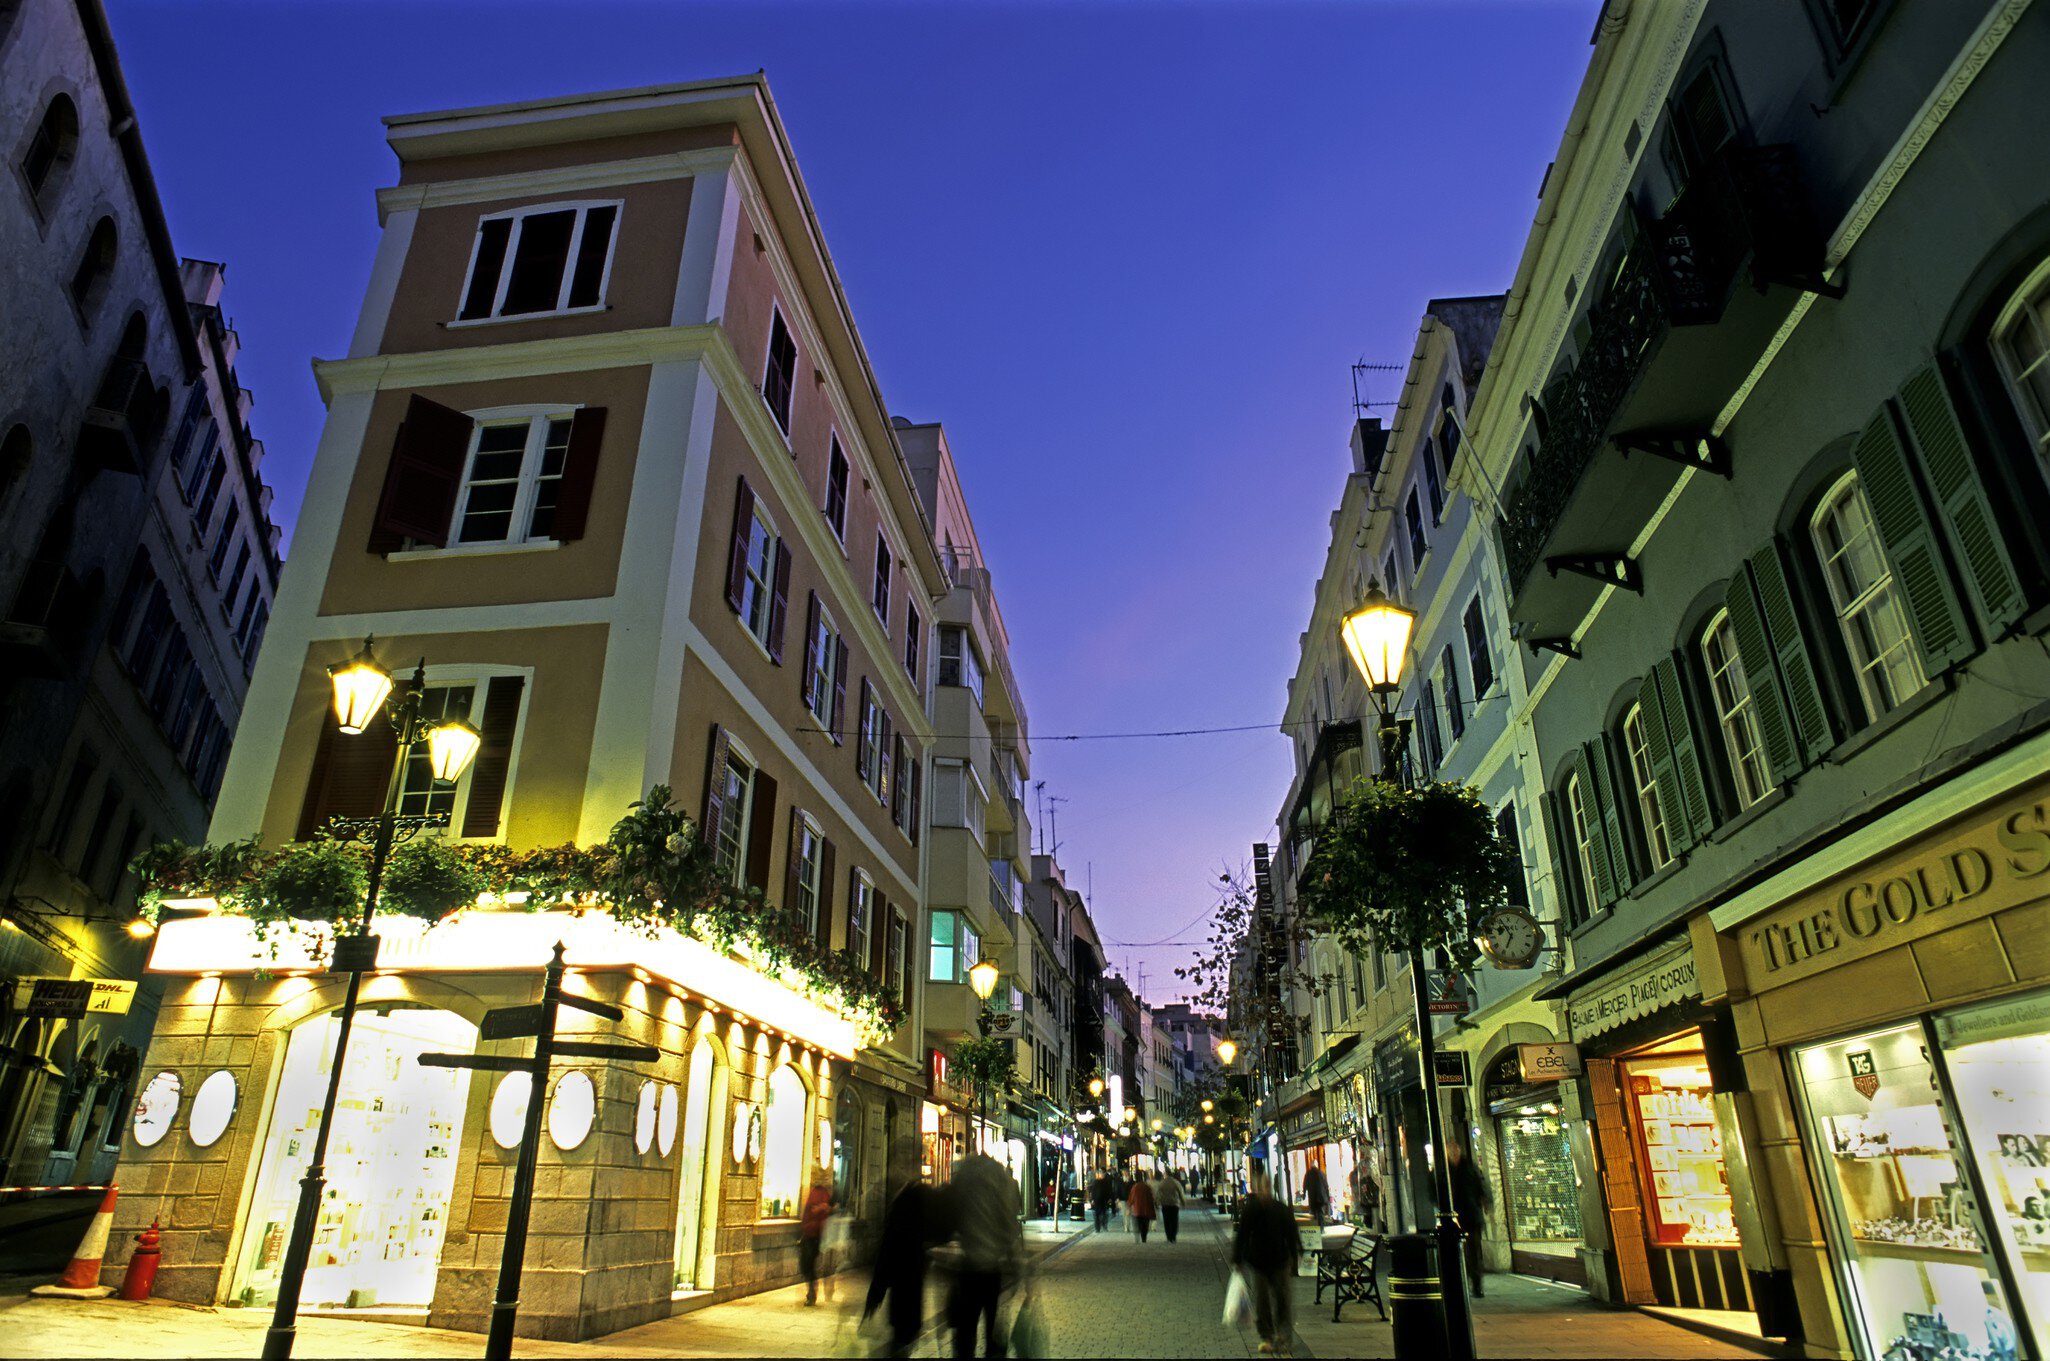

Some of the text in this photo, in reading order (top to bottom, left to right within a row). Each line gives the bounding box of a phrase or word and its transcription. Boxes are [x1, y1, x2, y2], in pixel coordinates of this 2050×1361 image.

[1750, 908, 1840, 972] THE
[1837, 847, 1993, 940] GOLD
[34, 981, 89, 999] HEIDI
[95, 983, 123, 992] DHL
[1956, 1016, 1998, 1034] Jewellers
[1998, 1008, 2016, 1026] and
[1536, 1056, 1569, 1068] EBEL
[1851, 1054, 1871, 1075] TAG
[1855, 1076, 1878, 1097] HEUER
